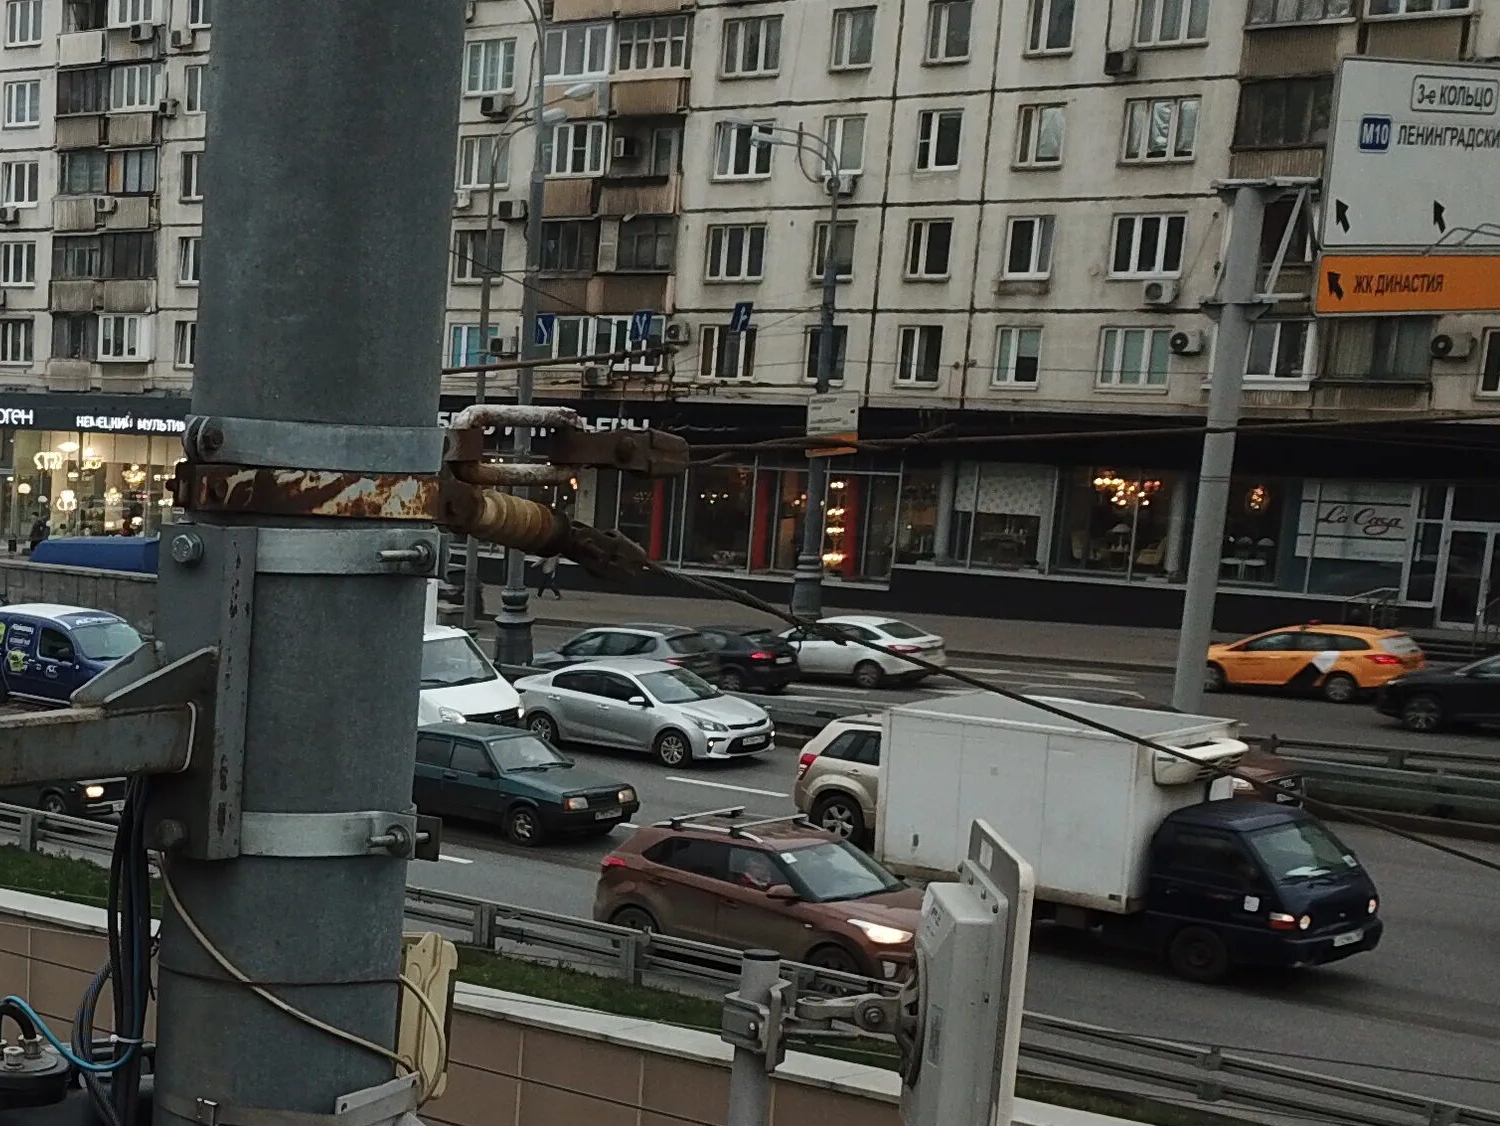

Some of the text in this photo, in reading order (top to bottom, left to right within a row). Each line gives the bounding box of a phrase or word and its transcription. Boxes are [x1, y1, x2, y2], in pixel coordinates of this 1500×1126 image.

[1439, 85, 1493, 110] КОЛЬЦО
[1362, 123, 1389, 145] М10
[1353, 274, 1444, 296] ЖК ДИНАСТИЯ
